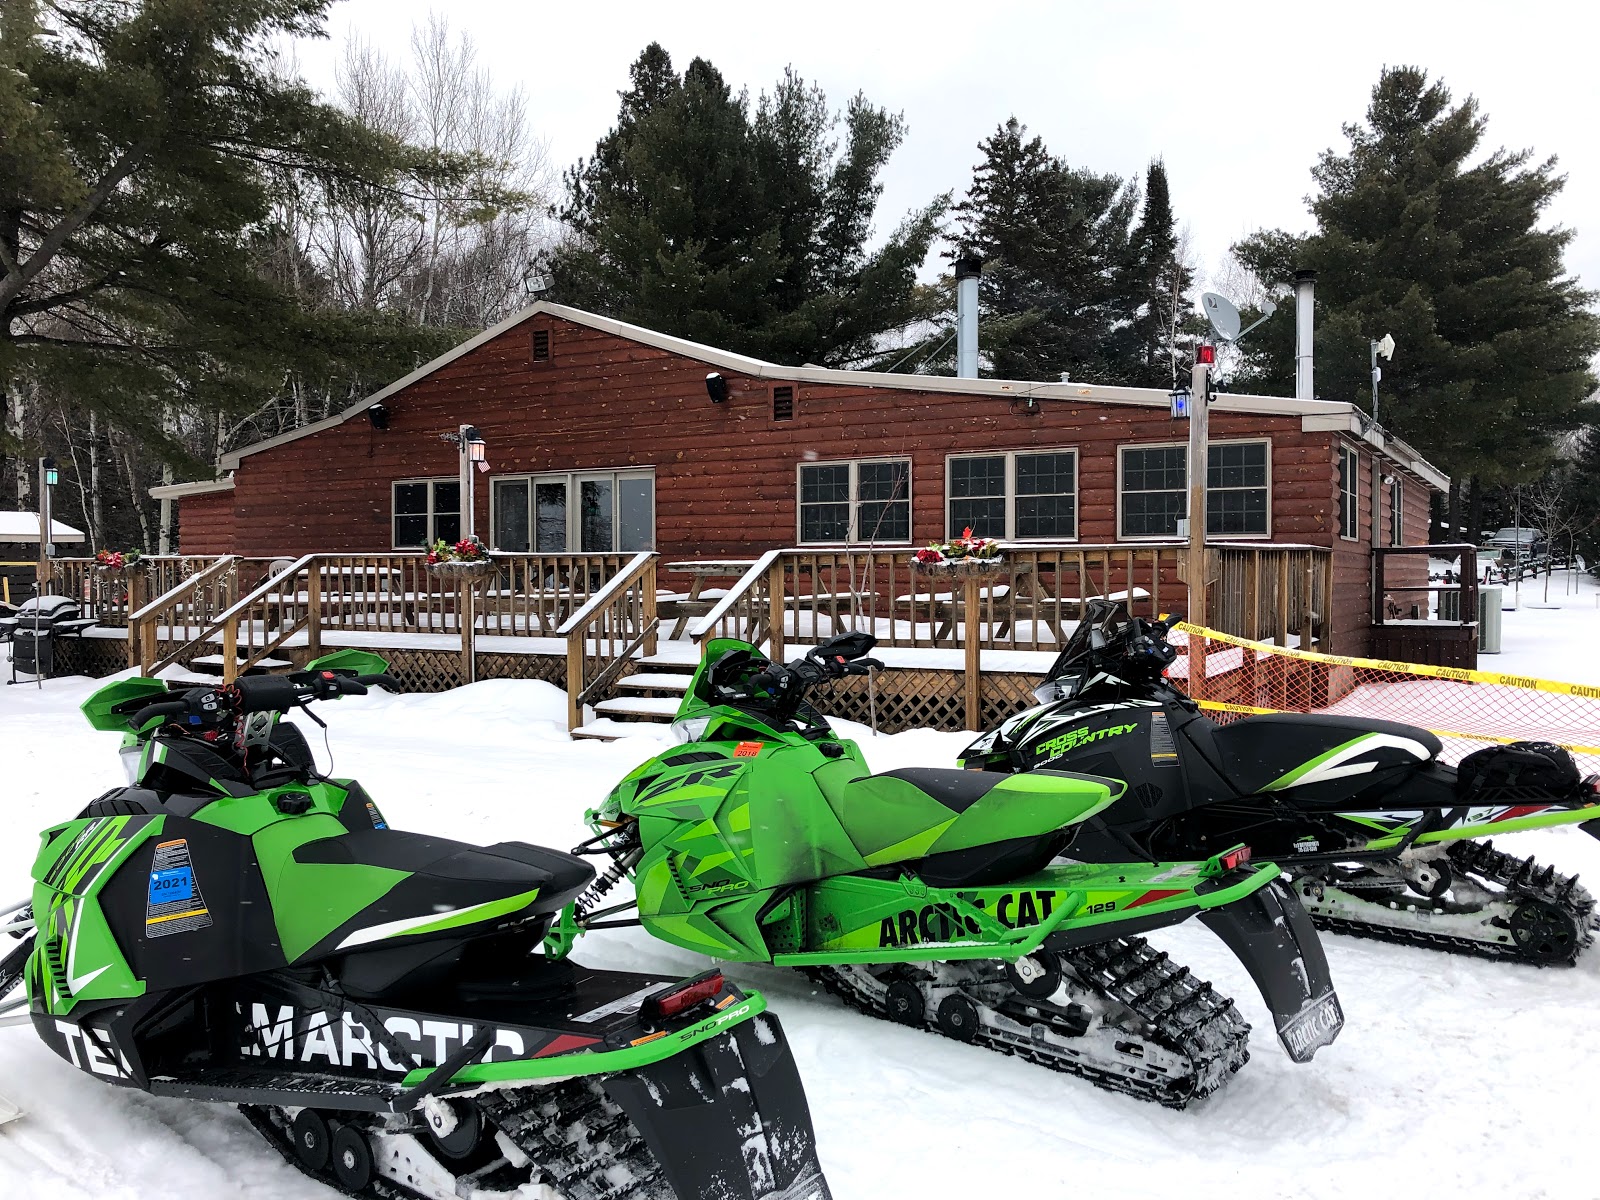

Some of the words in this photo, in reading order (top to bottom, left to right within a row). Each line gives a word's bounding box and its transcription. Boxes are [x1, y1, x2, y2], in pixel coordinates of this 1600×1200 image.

[1178, 623, 1205, 636] CAUTION
[1225, 635, 1252, 647] CAUTION
[1323, 655, 1353, 665] CAUTION
[1377, 661, 1410, 672] CAUTION
[1435, 668, 1471, 680] CAUTION
[1499, 675, 1538, 690] CAUTION
[1035, 725, 1090, 756] CROSS
[1049, 722, 1138, 759] COUNTRY
[153, 876, 187, 891] 2021
[688, 879, 731, 893] SNO
[706, 880, 749, 896] PRO
[996, 889, 1057, 930] CAT
[1085, 901, 1117, 915] 129
